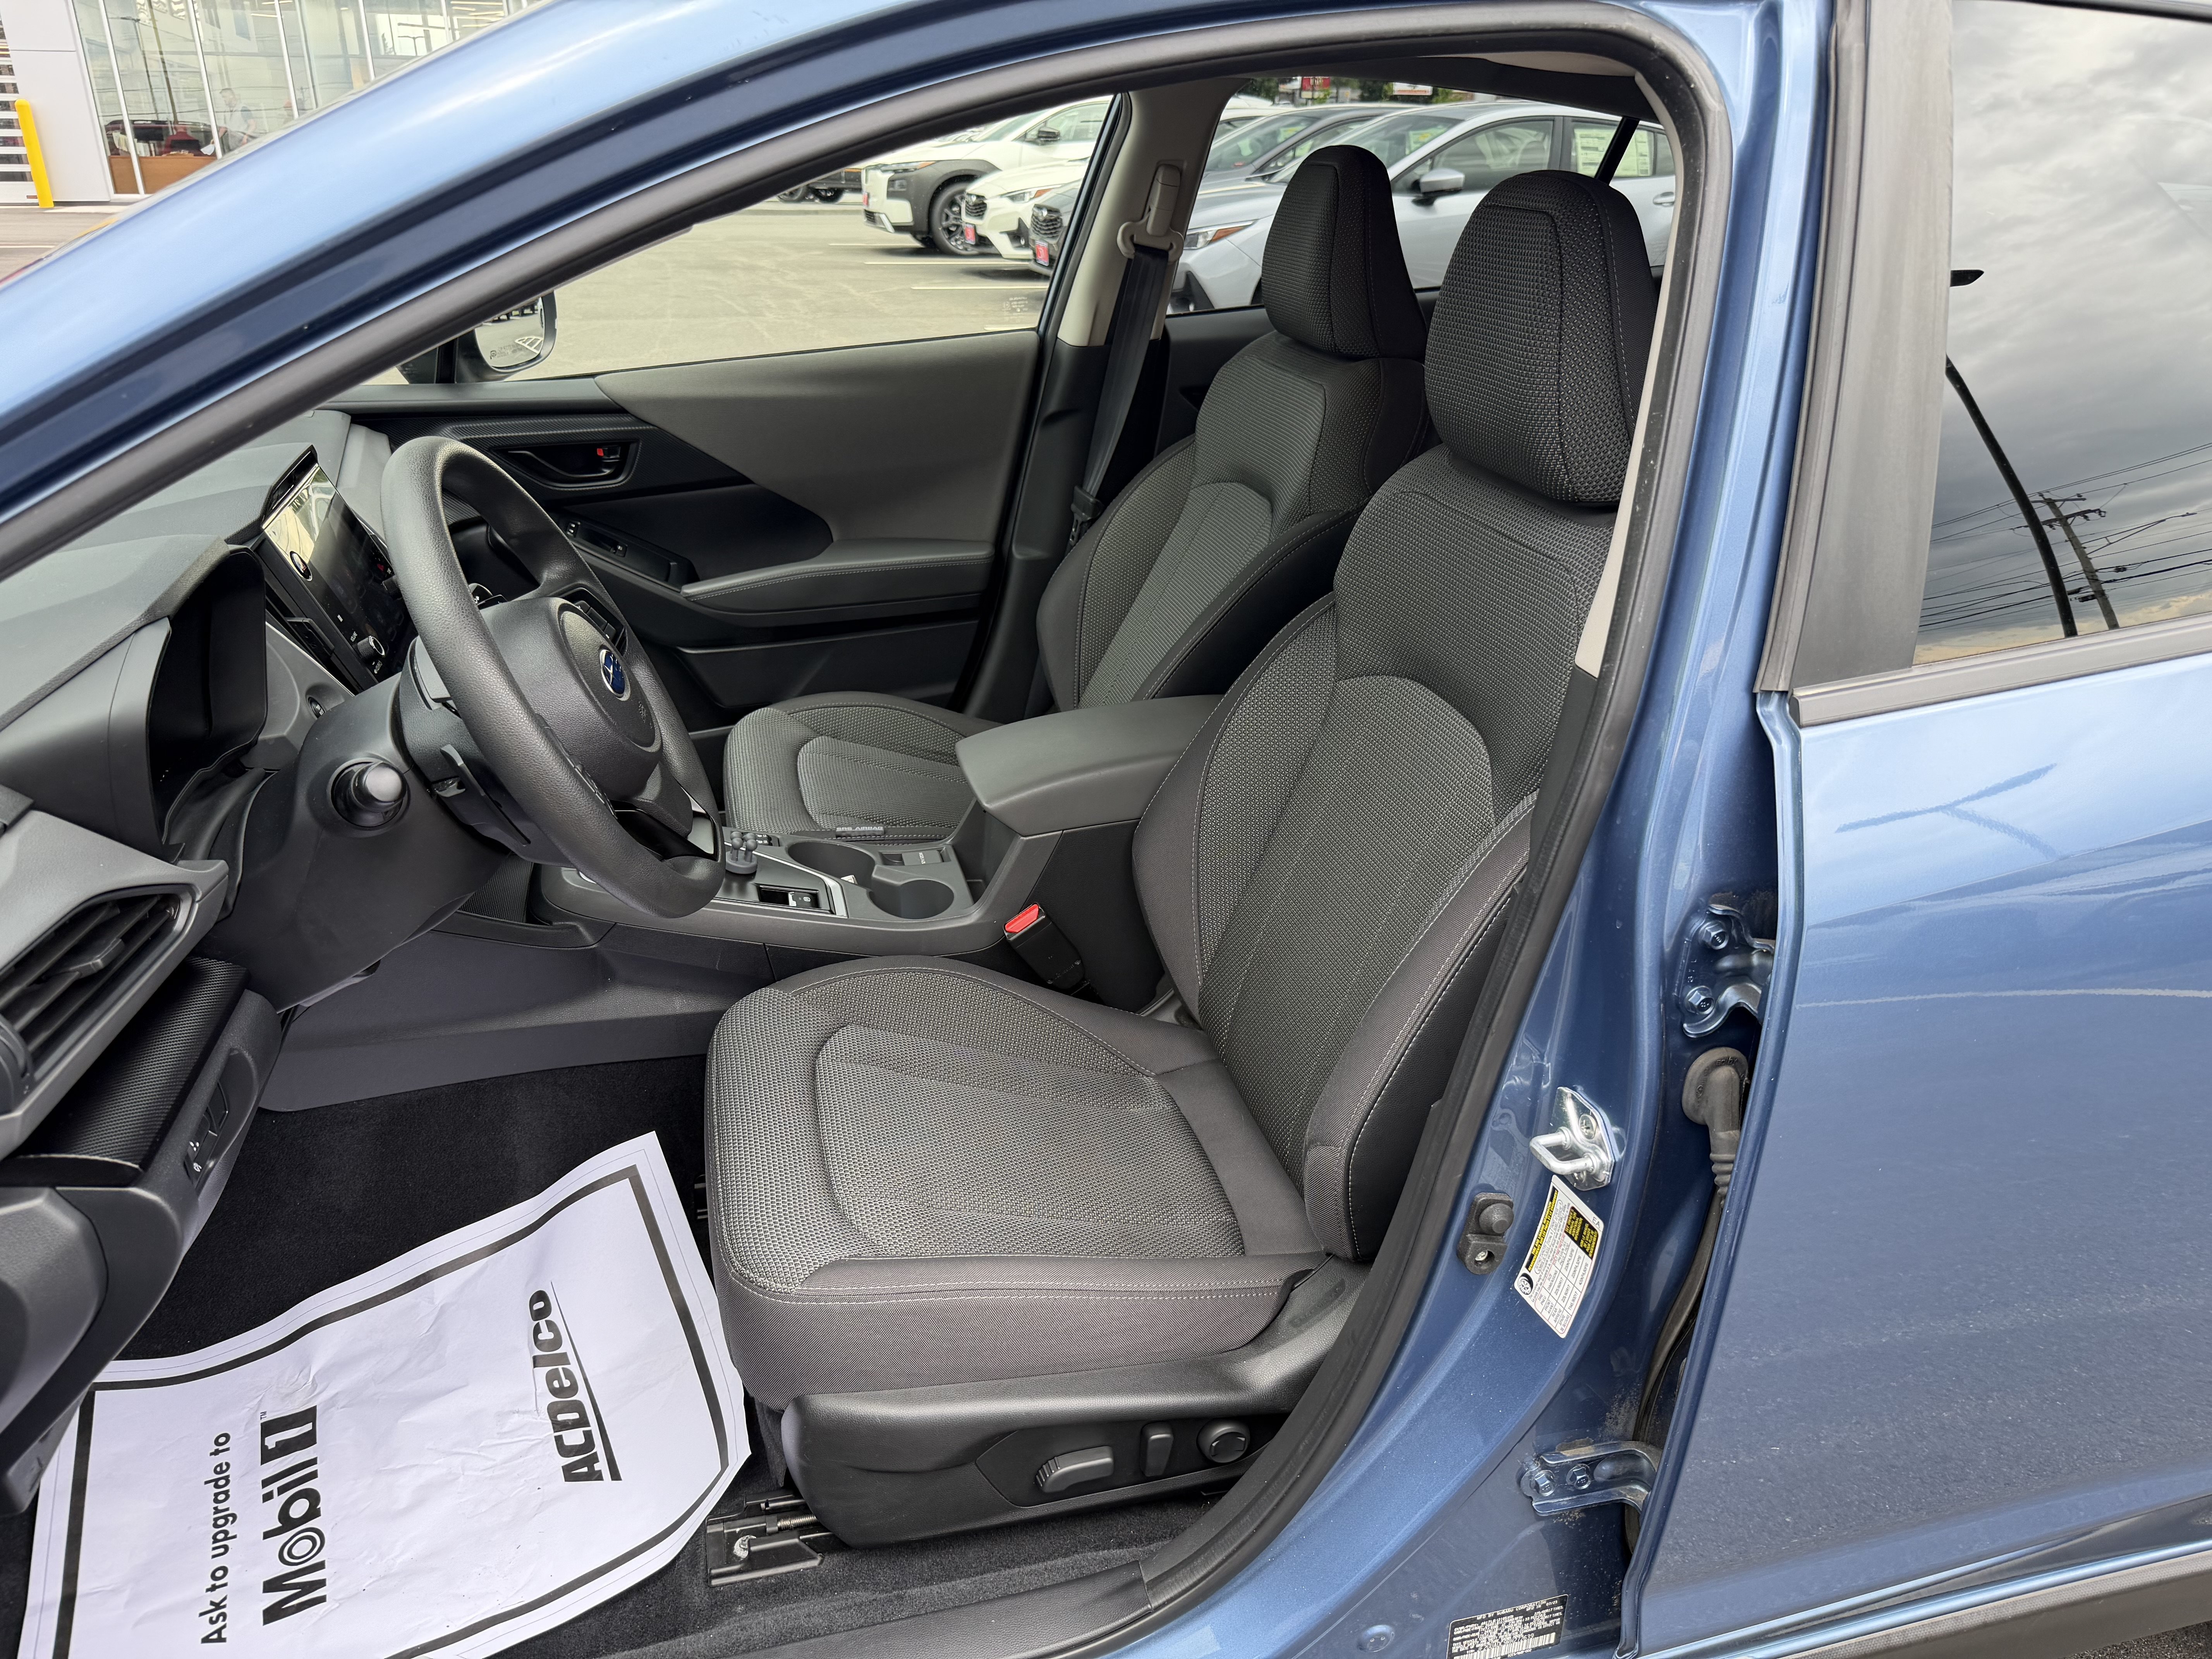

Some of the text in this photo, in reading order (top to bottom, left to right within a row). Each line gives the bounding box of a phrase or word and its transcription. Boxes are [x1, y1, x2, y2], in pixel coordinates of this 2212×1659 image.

[1592, 1216, 1600, 1228] EA
[529, 1290, 604, 1482] ACDelco
[198, 1432, 237, 1644] Ask to upgrade to
[261, 1456, 327, 1626] Mobil
